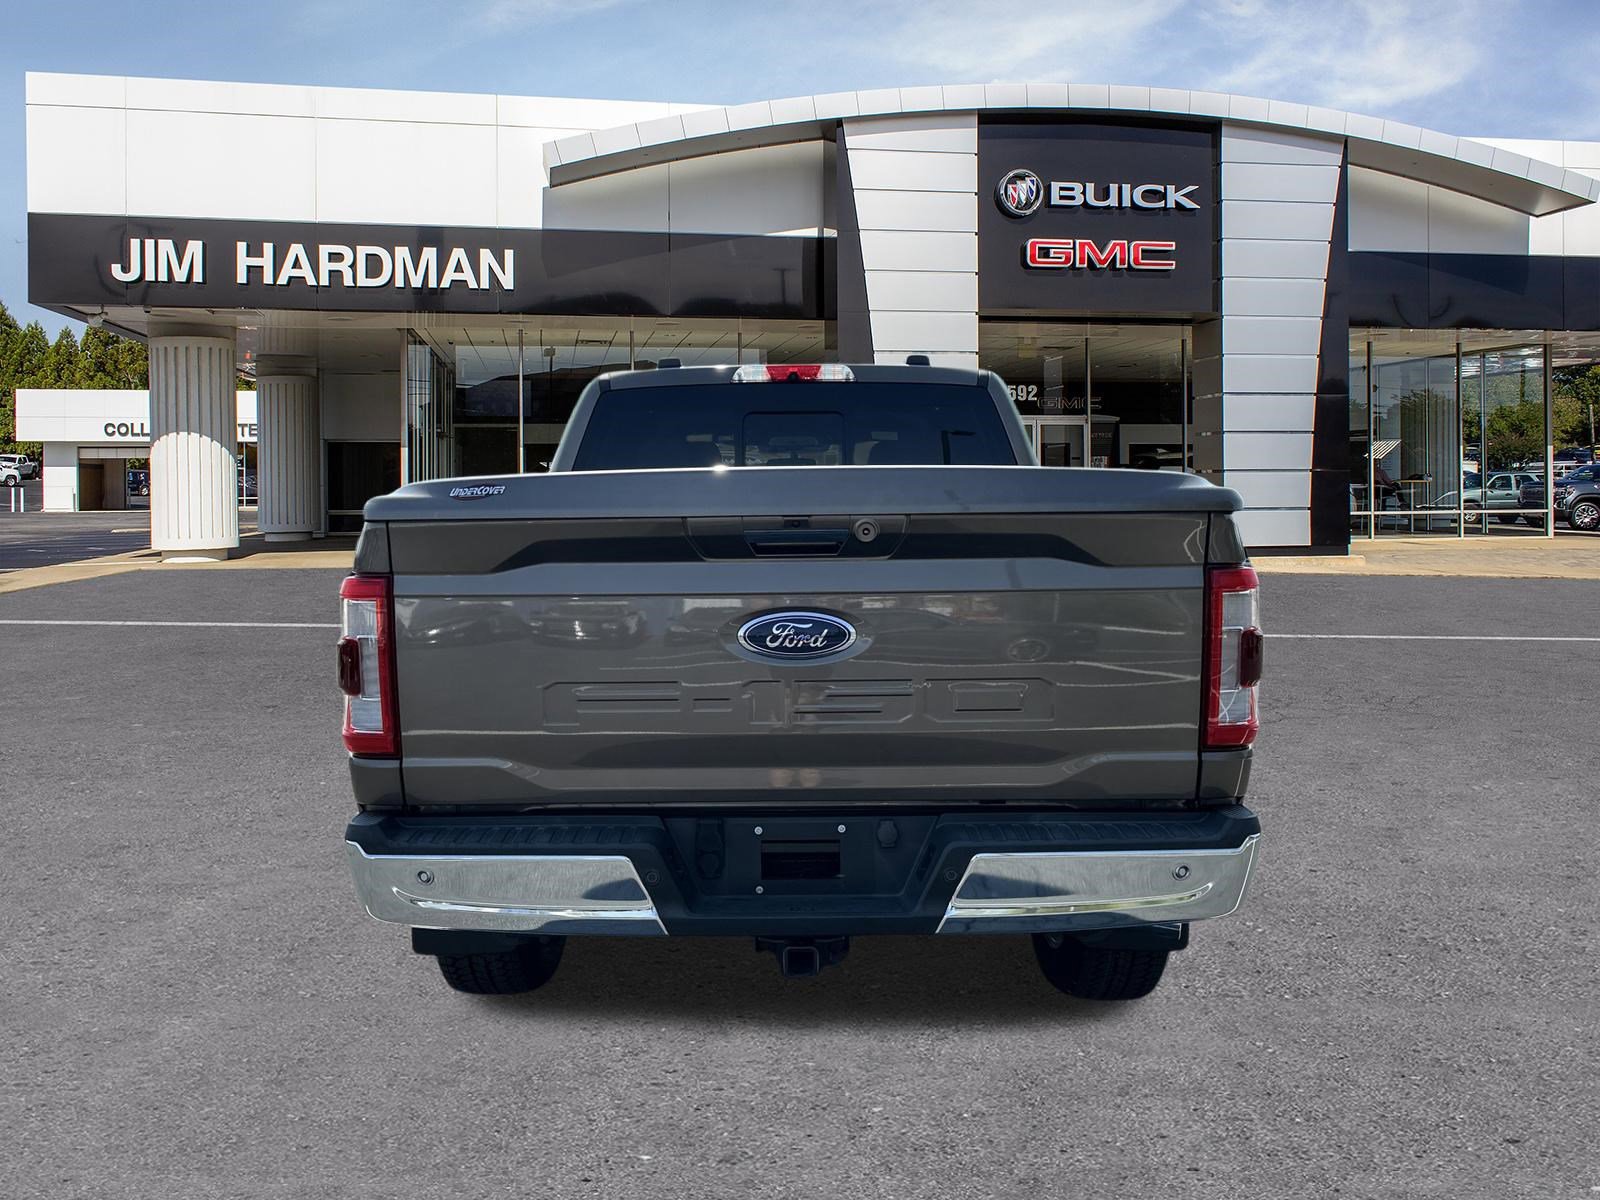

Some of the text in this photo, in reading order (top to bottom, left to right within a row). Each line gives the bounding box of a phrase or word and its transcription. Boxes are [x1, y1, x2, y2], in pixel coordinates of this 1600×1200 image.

[1050, 181, 1200, 209] BUICK
[111, 239, 514, 289] JIM HARDMAN
[1026, 238, 1176, 270] GMC
[1037, 396, 1103, 409] GMC
[104, 422, 150, 437] COLL
[765, 622, 828, 648] Ford
